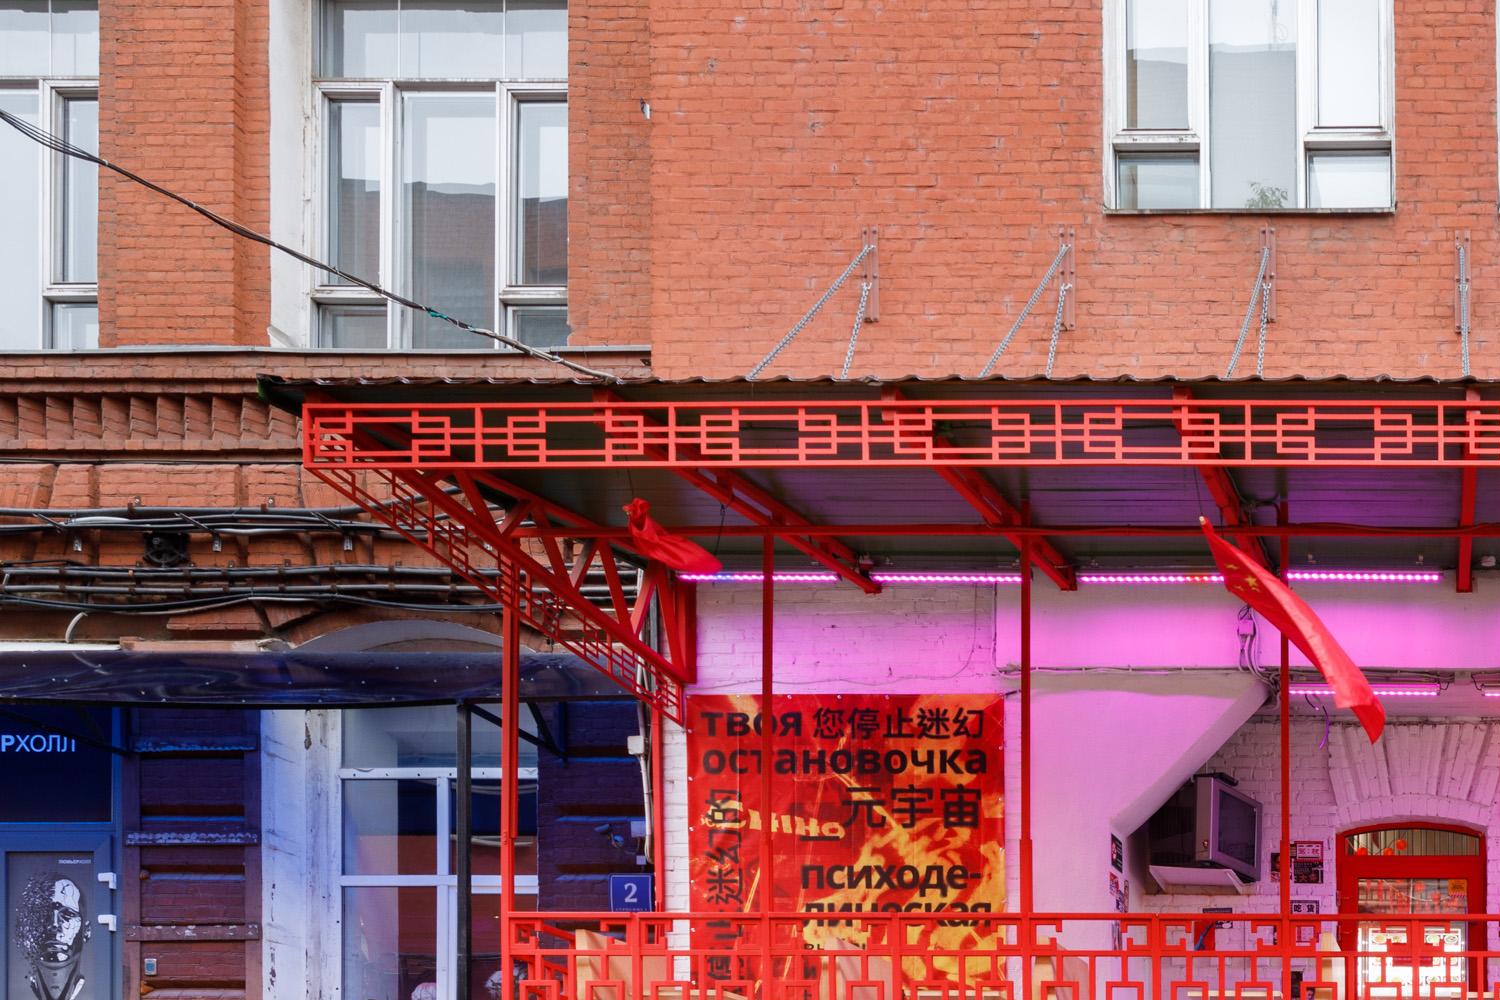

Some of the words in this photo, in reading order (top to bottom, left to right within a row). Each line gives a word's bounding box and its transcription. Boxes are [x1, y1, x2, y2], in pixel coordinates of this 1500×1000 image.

[702, 748, 988, 775] остановочка
[841, 784, 982, 829] 元宇宙
[624, 882, 638, 903] 2
[801, 864, 982, 898] психоде-
